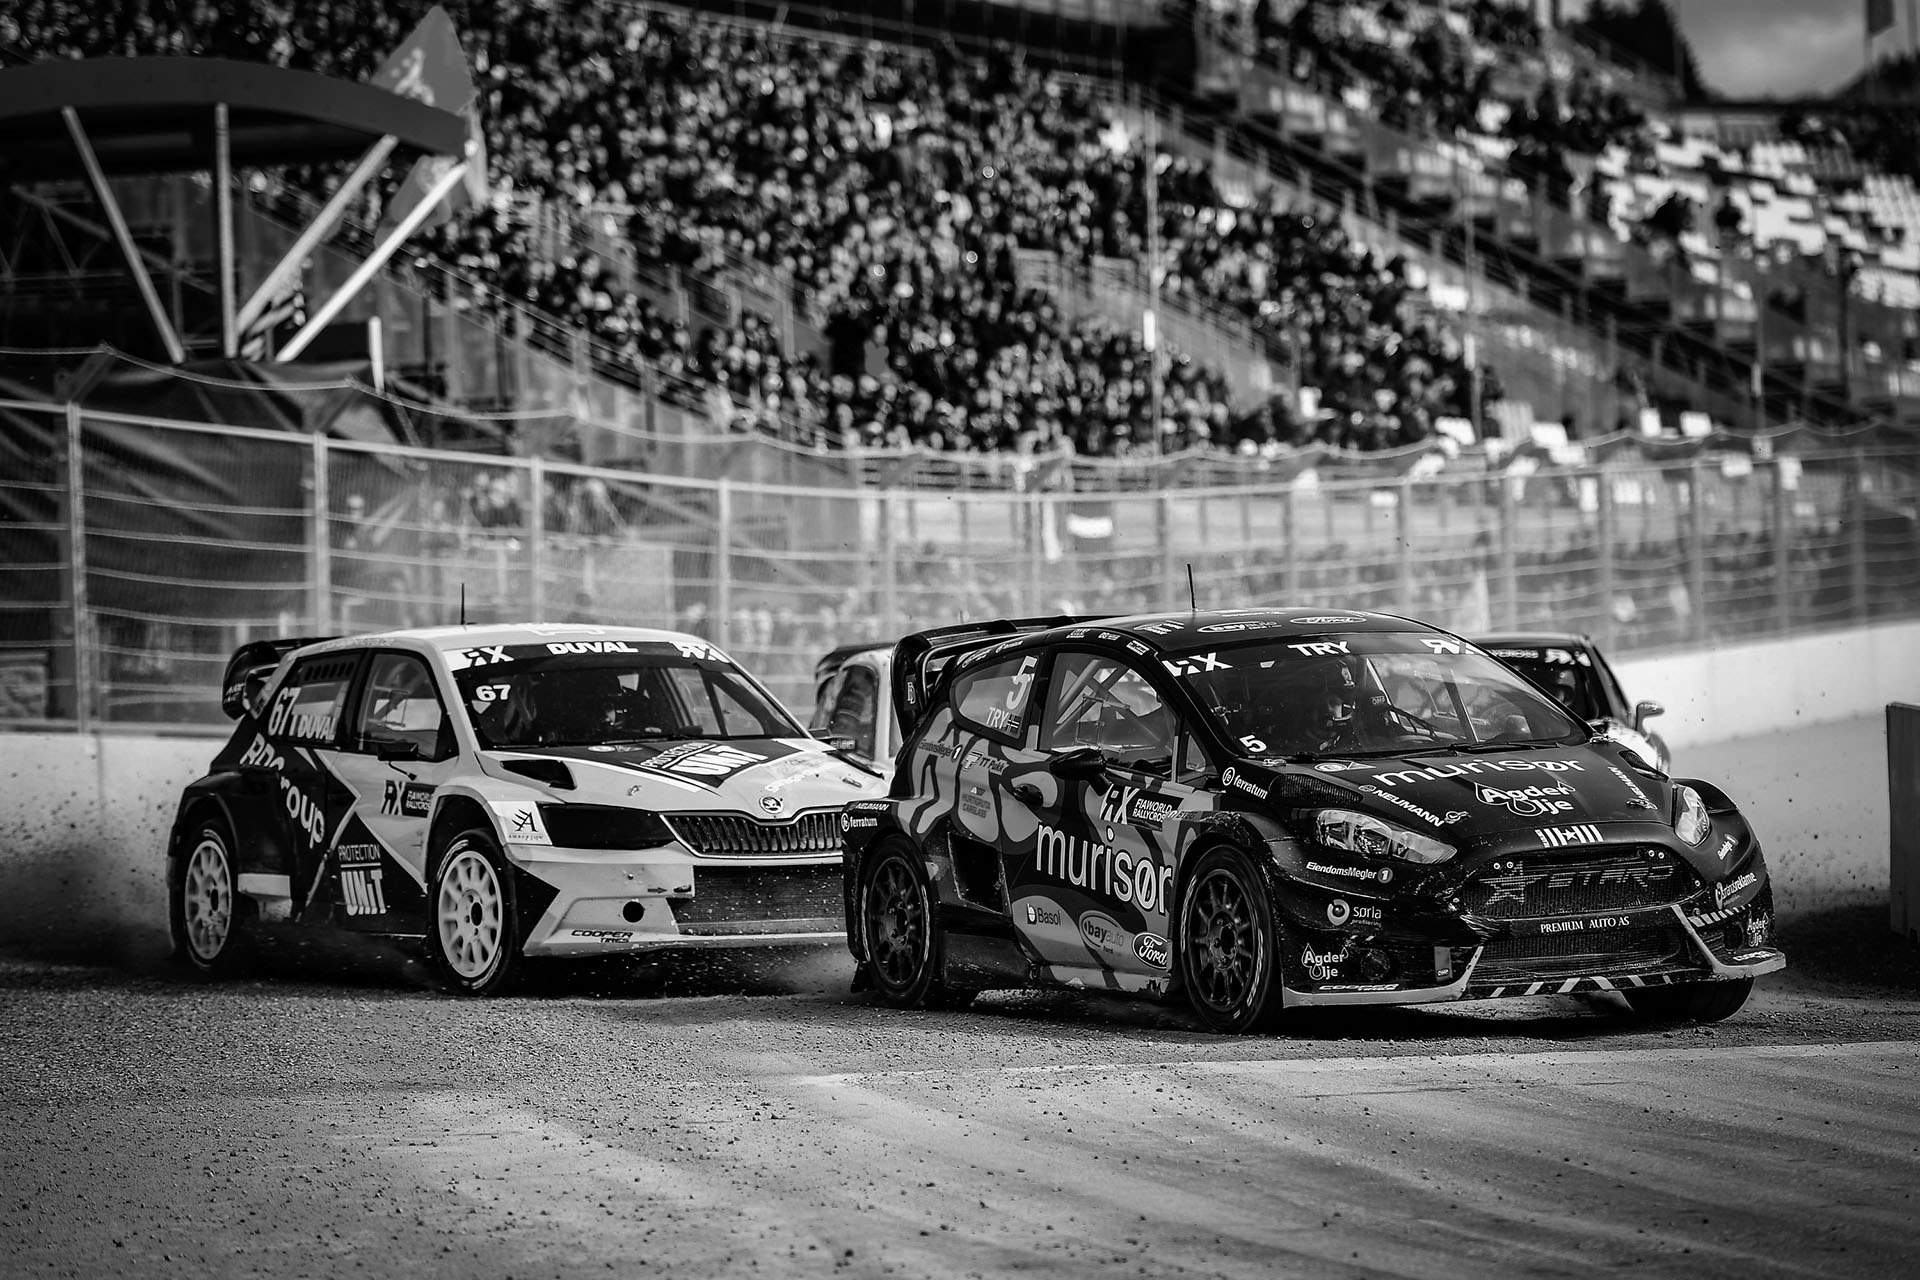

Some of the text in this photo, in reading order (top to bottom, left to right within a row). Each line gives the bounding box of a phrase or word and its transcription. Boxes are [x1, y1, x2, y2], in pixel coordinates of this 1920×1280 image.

[546, 642, 639, 655] DUVAL
[1287, 641, 1348, 656] TRY
[1490, 649, 1539, 659] YCROSS
[1006, 655, 1038, 711] 5
[475, 683, 512, 702] 67
[268, 687, 301, 736] 67
[986, 707, 1010, 729] TRY
[297, 714, 337, 740] DUVAL
[1239, 735, 1268, 752] 5
[1372, 758, 1586, 786] murisør
[1233, 776, 1269, 799] ferratum
[1482, 784, 1571, 802] Agder
[1132, 808, 1166, 822] RALLYCROS
[1372, 789, 1444, 827] NEUMANN
[850, 816, 878, 828] ferratum
[338, 844, 380, 861] PROTECTION
[1036, 825, 1171, 914] murisør
[1306, 862, 1377, 880] EiendomsMegler
[341, 869, 387, 916] UNIT
[1037, 907, 1062, 926] Basol
[1353, 906, 1382, 919] sørla
[571, 930, 634, 938] COOPER
[1540, 917, 1630, 933] PREMIUM AUTO AS
[1138, 936, 1168, 966] Ford
[1304, 950, 1345, 965] Agder
